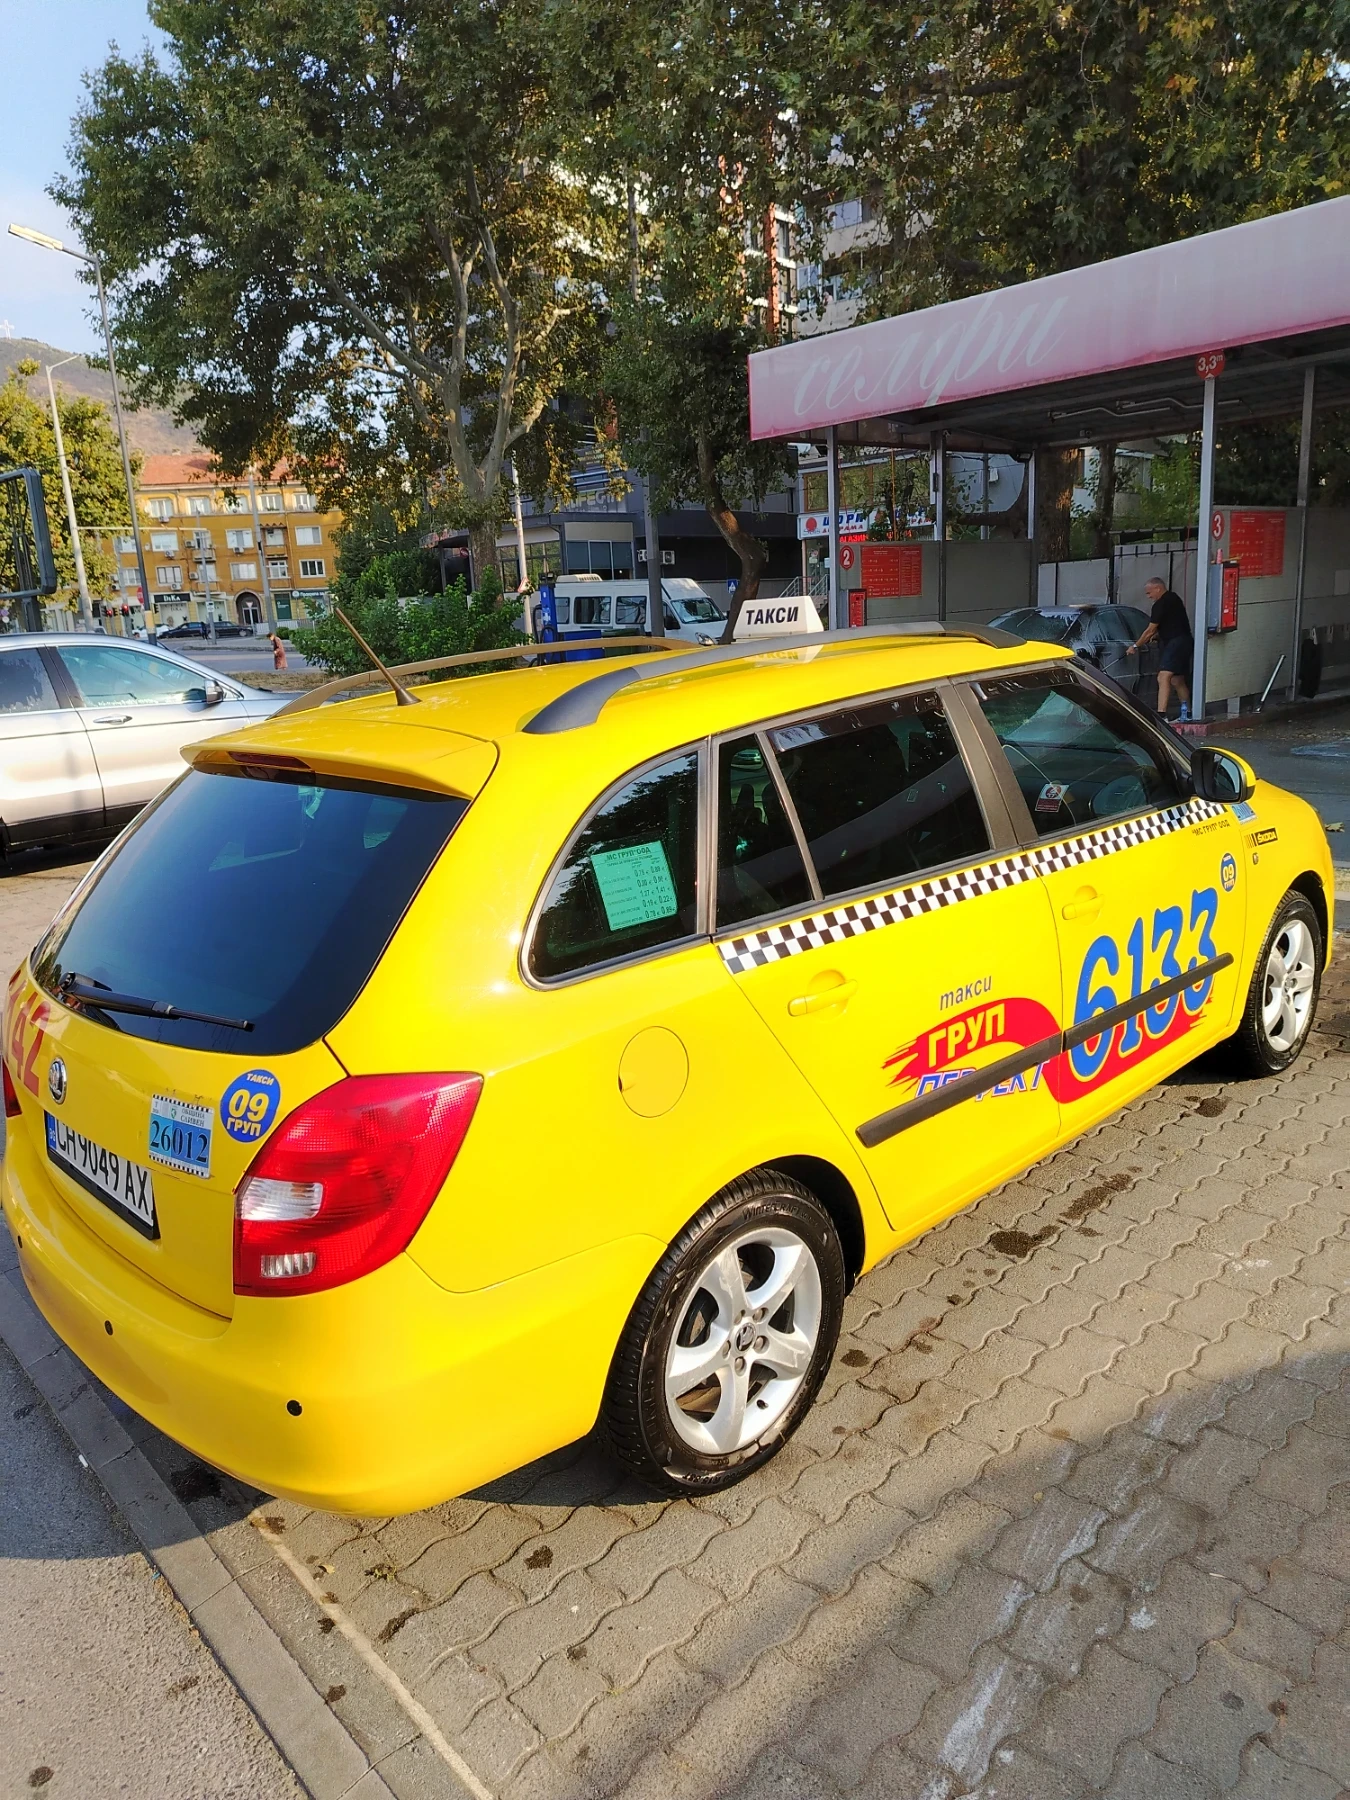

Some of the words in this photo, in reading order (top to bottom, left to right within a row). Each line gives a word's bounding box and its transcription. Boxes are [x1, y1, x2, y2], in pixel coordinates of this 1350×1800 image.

[1213, 514, 1221, 537] 3
[839, 534, 869, 543] АГАЗИН
[843, 550, 850, 566] 2
[746, 606, 799, 625] ТАКСИ
[1222, 863, 1234, 882] 09
[1069, 887, 1219, 1083] 6133
[928, 1003, 1006, 1068] ГРУП
[246, 1073, 275, 1086] ТАКСИ
[915, 1059, 1051, 1102] ПЕЕКТ
[228, 1089, 270, 1122] 09
[226, 1117, 262, 1137] ГРУП
[150, 1120, 208, 1163] 26012
